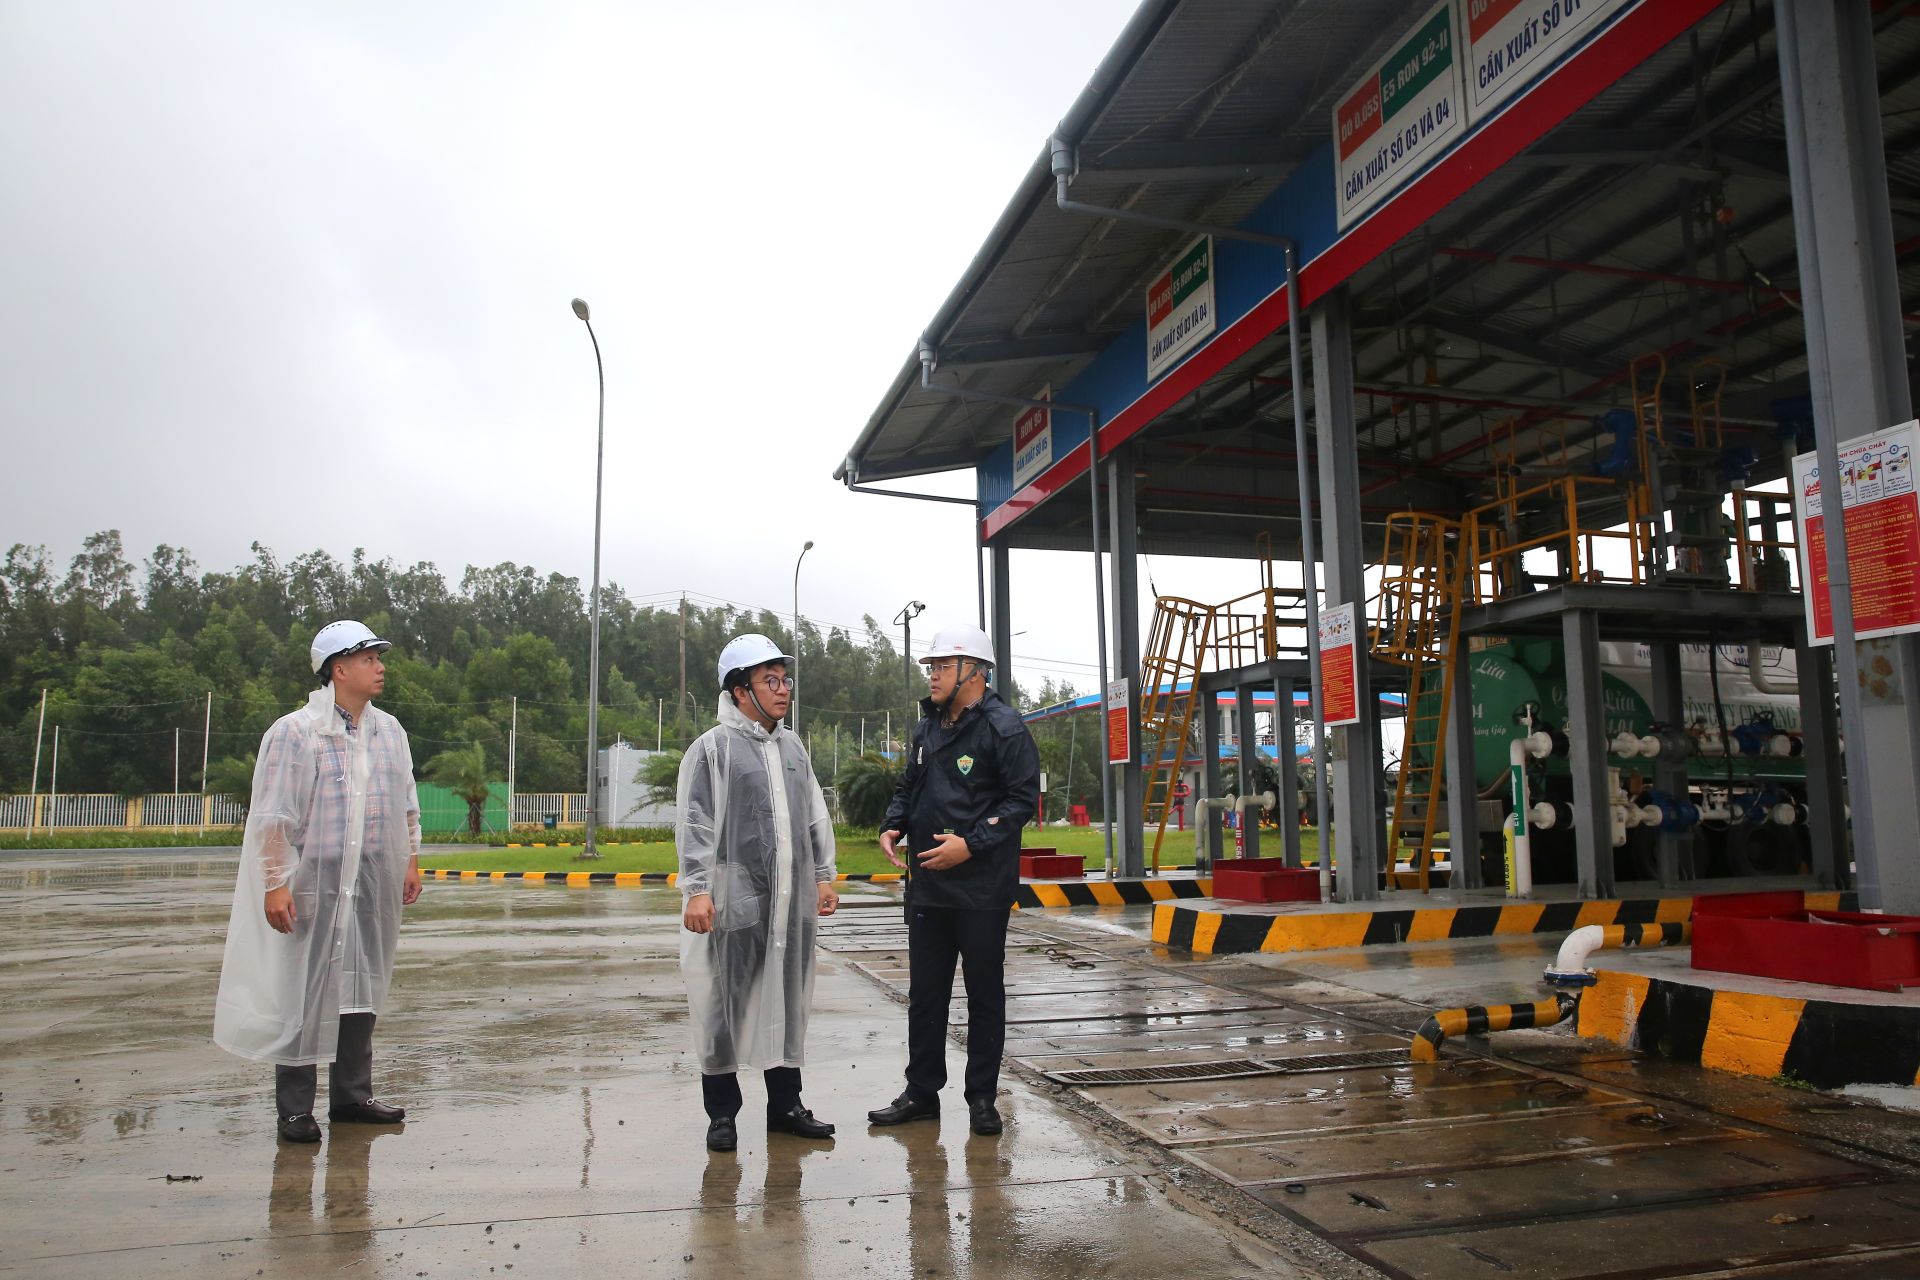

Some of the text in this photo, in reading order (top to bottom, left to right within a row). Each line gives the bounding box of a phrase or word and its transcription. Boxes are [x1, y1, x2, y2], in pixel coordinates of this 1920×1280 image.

[1382, 28, 1448, 104] E5 RON 92-II
[1506, 16, 1539, 67] XUẤT
[1342, 94, 1379, 142] DO 0.05S
[1365, 145, 1388, 186] XUẤT
[1390, 129, 1404, 164] SỐ
[1405, 123, 1418, 151] 03
[1420, 107, 1435, 138] VÀ
[1435, 97, 1450, 126] 04
[1199, 302, 1207, 322] 04
